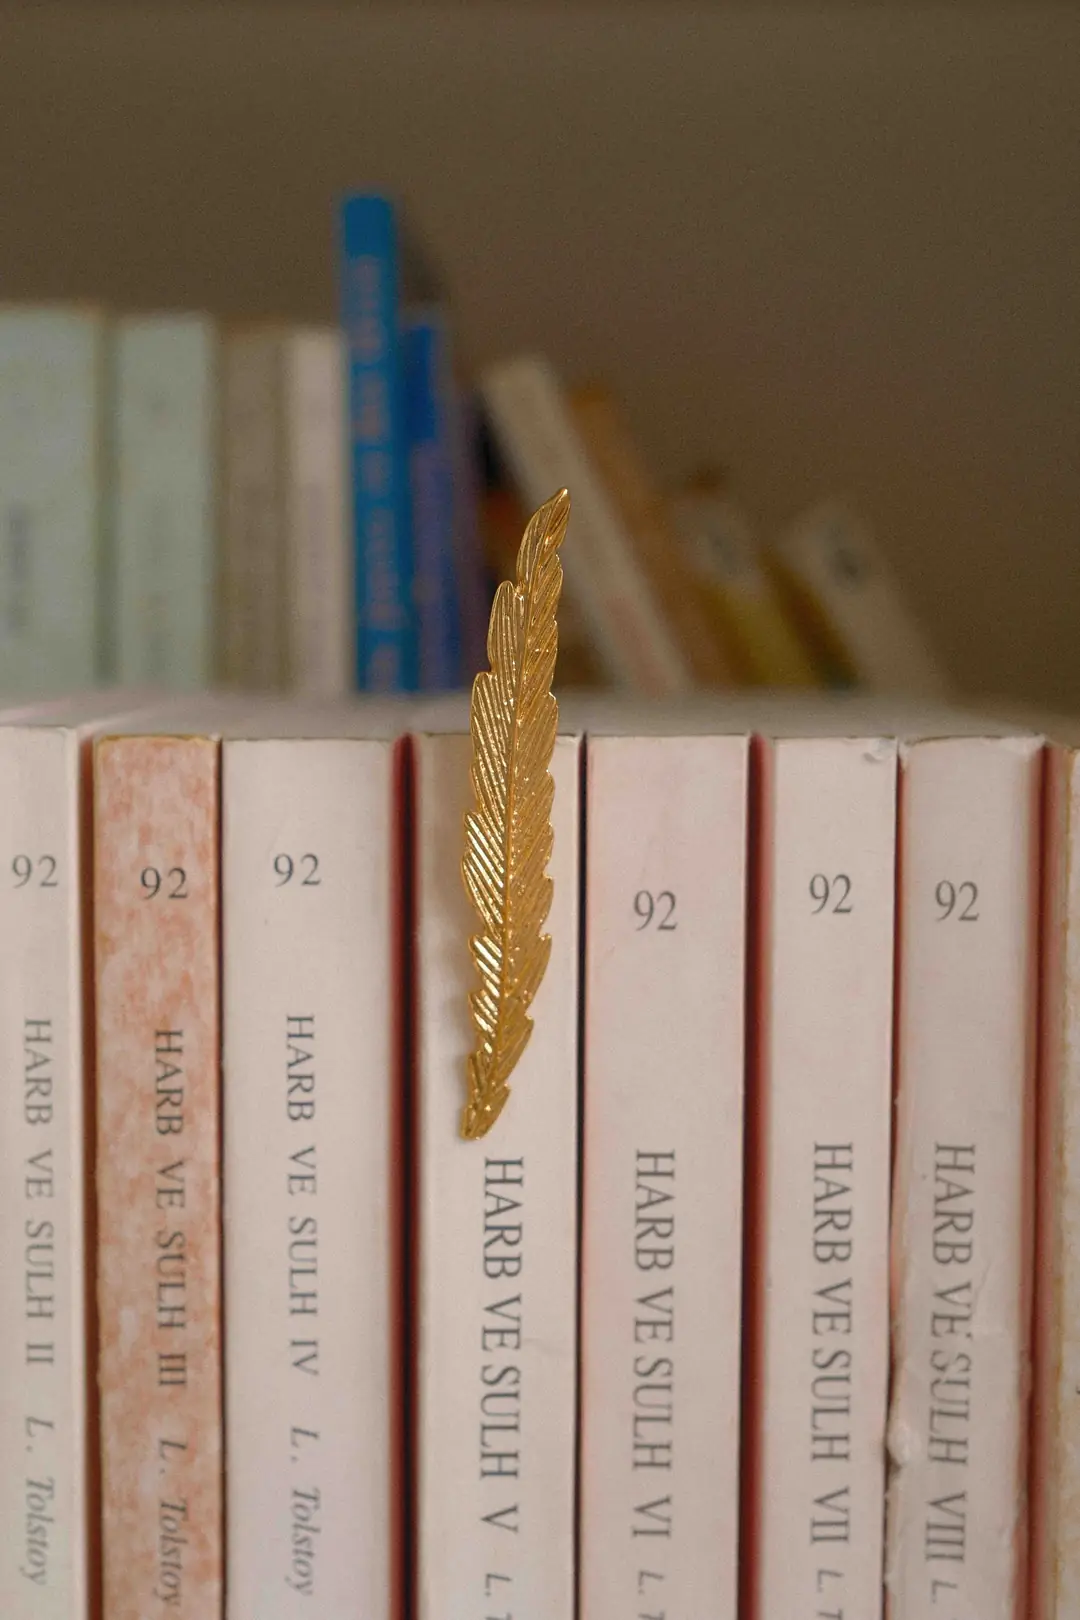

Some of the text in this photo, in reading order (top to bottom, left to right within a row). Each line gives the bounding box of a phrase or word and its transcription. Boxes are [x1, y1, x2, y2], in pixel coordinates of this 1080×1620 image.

[11, 854, 59, 888] 92
[139, 864, 189, 901] 92
[272, 852, 322, 887] 92
[808, 873, 853, 915] 92
[632, 889, 678, 932] 92
[934, 879, 980, 922] 92
[482, 1156, 525, 1280] HARB
[634, 1149, 676, 1272] HARB
[812, 1142, 854, 1265] HARB
[932, 1142, 976, 1266] HARB
[20, 1019, 55, 1585] HARB VE SULH II L. Tolstoy
[152, 1028, 189, 1608] HARB VE SULH III L. Tolstoy
[285, 1015, 321, 1595] HARB VE SULH IV L. Tolstoy
[480, 1292, 523, 1352] VE
[633, 1285, 675, 1344] VE
[811, 1277, 853, 1336] VE
[930, 1280, 973, 1339] VE
[479, 1364, 522, 1479] SULH
[631, 1355, 674, 1471] SULH
[810, 1348, 853, 1462] SULH
[928, 1349, 972, 1466] SULH
[479, 1503, 520, 1534] V
[631, 1494, 673, 1538] VI
[810, 1485, 851, 1544] VII
[924, 1491, 967, 1563] VIII
[484, 1572, 513, 1598] L.
[637, 1570, 665, 1595] L.
[816, 1568, 844, 1593] L.
